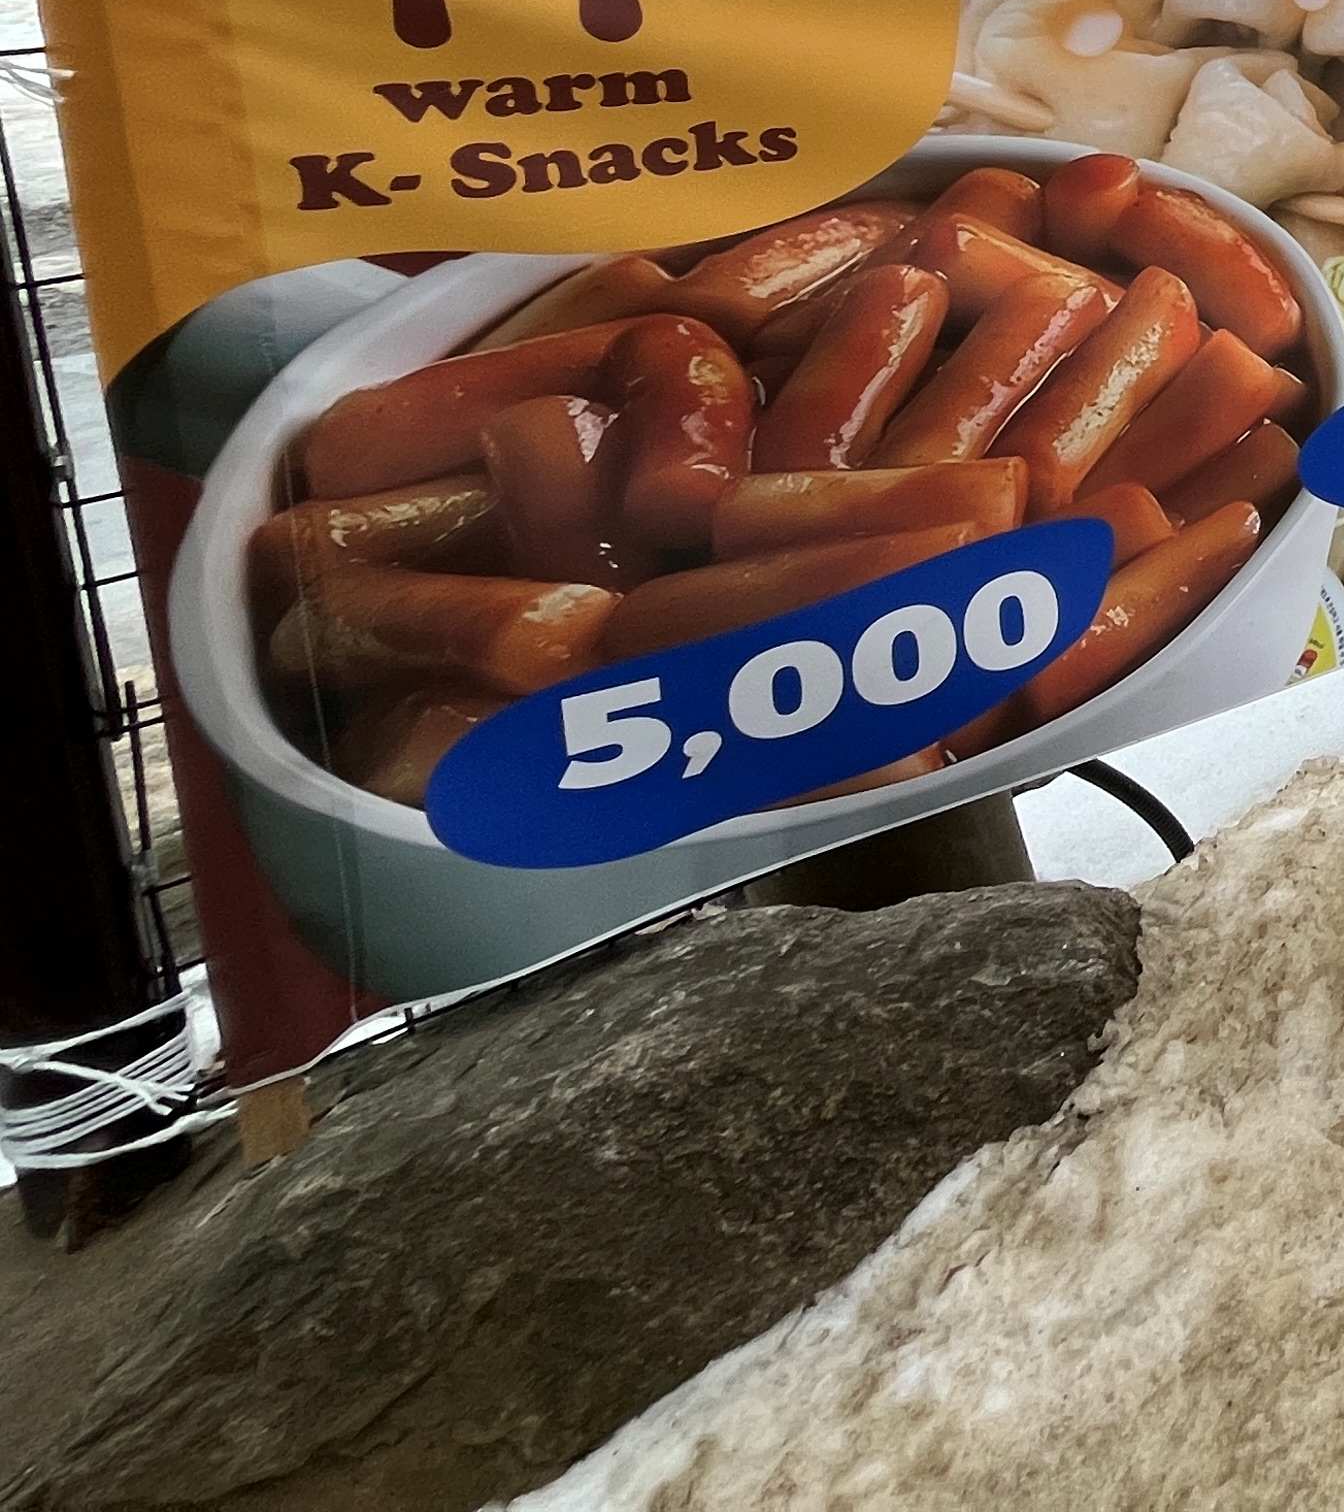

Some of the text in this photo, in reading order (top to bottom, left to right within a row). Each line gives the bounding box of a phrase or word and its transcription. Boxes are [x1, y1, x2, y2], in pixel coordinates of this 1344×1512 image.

[373, 68, 692, 123] warm
[289, 120, 799, 211] K- Snacks
[557, 570, 1060, 790] 5,000
